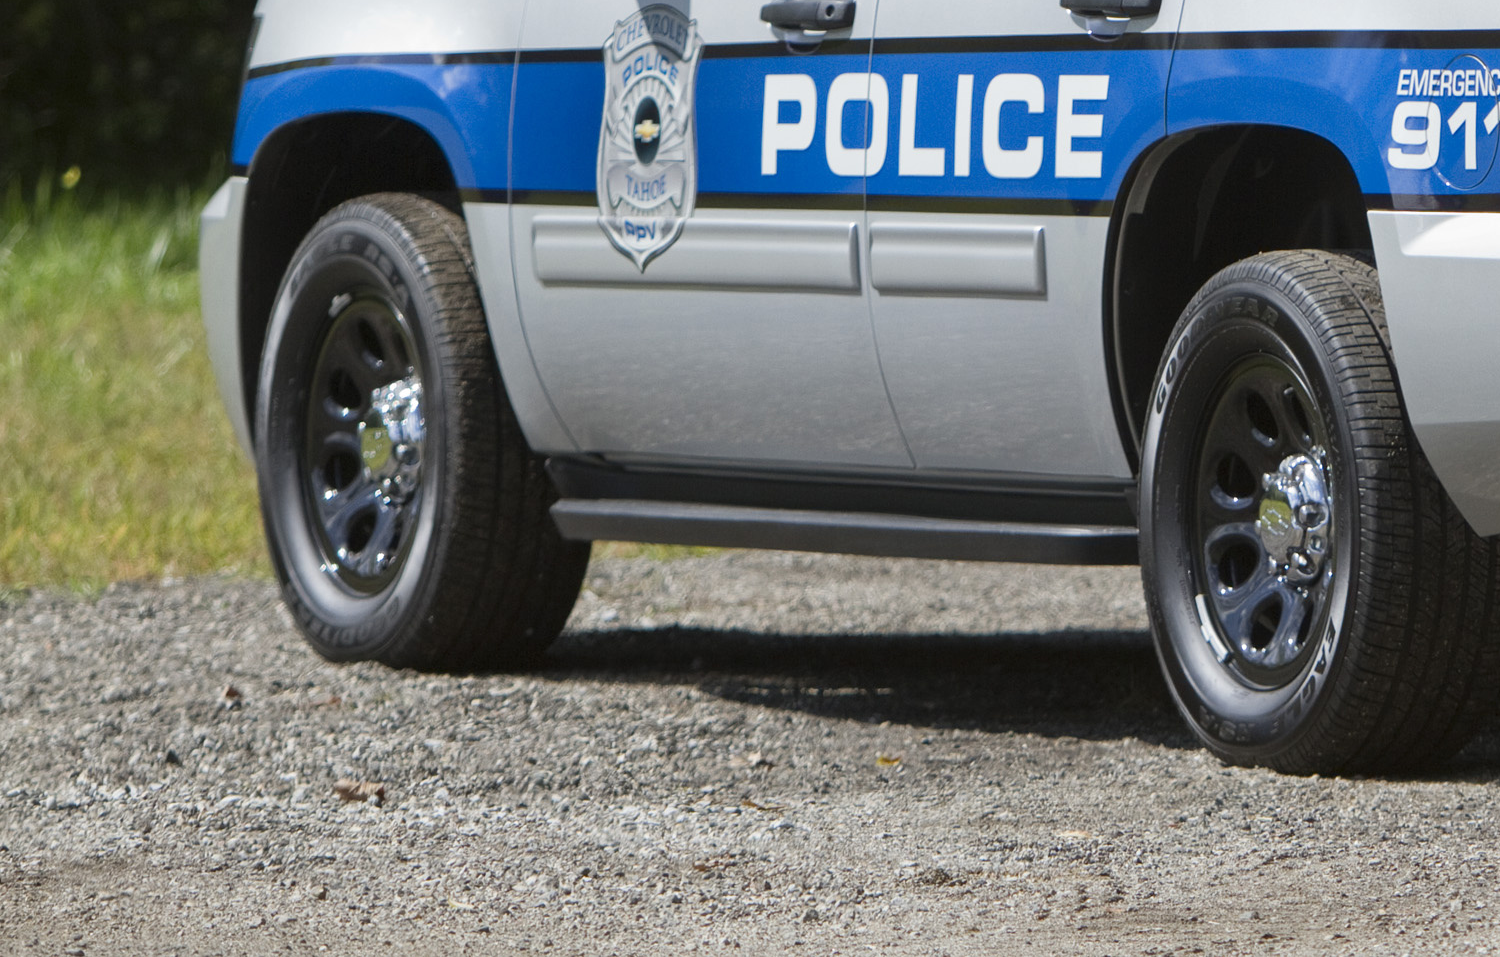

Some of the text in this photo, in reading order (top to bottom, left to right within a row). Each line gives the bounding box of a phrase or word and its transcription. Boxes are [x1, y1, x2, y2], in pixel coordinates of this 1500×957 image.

[616, 12, 689, 52] CHEVROLET
[621, 53, 679, 88] POLICE
[761, 72, 1110, 179] POLICE
[625, 174, 667, 202] TAHOE
[624, 219, 657, 242] PPV
